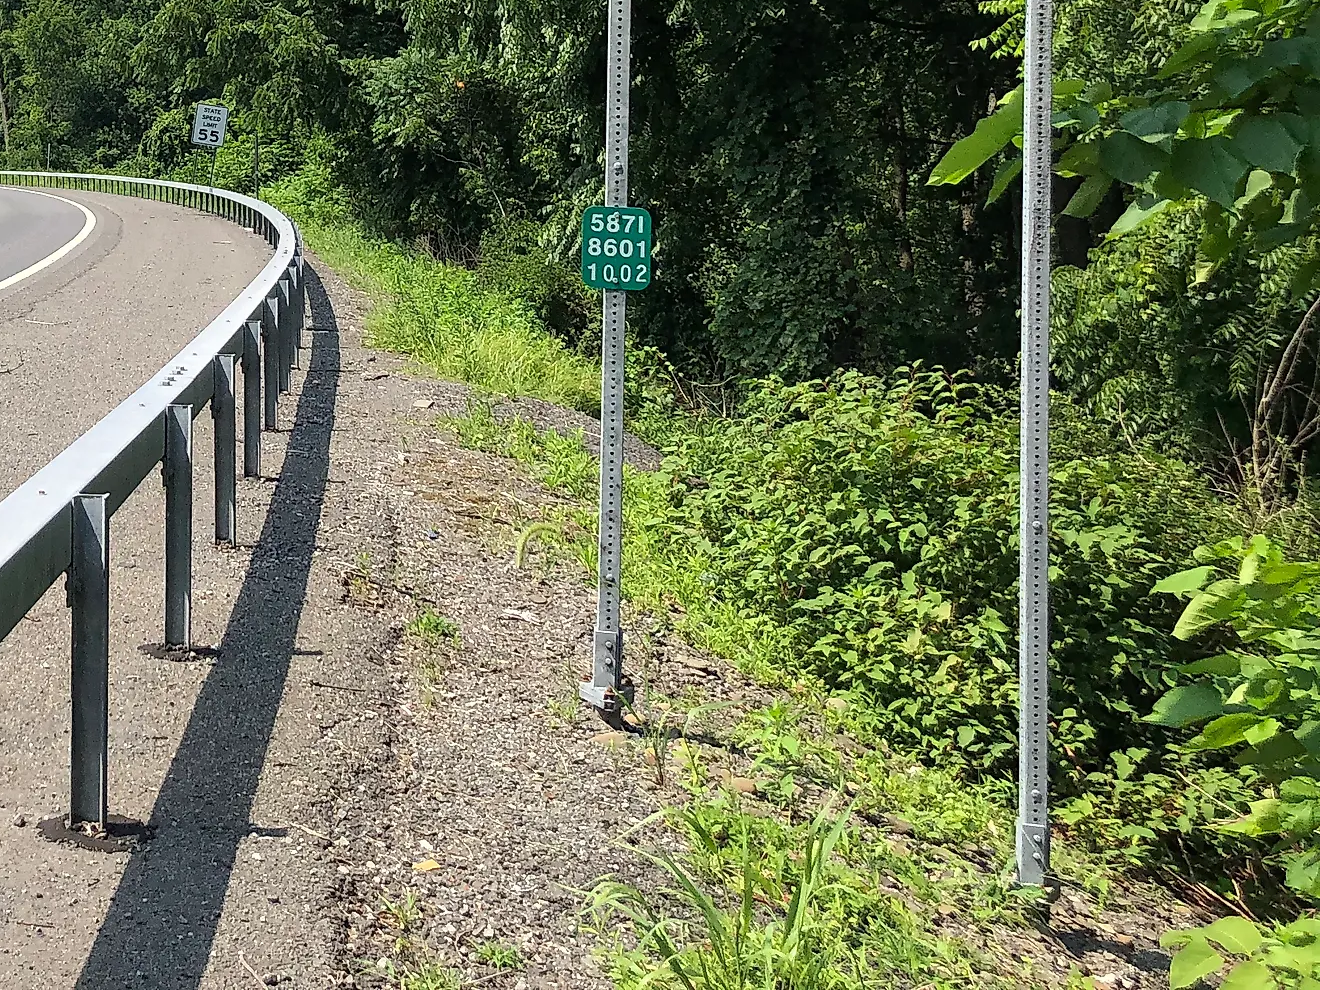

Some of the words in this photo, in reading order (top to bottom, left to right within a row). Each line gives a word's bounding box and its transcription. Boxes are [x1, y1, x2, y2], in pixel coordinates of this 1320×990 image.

[201, 114, 221, 122] SPEED
[198, 129, 219, 142] 55
[587, 237, 646, 258] 8601
